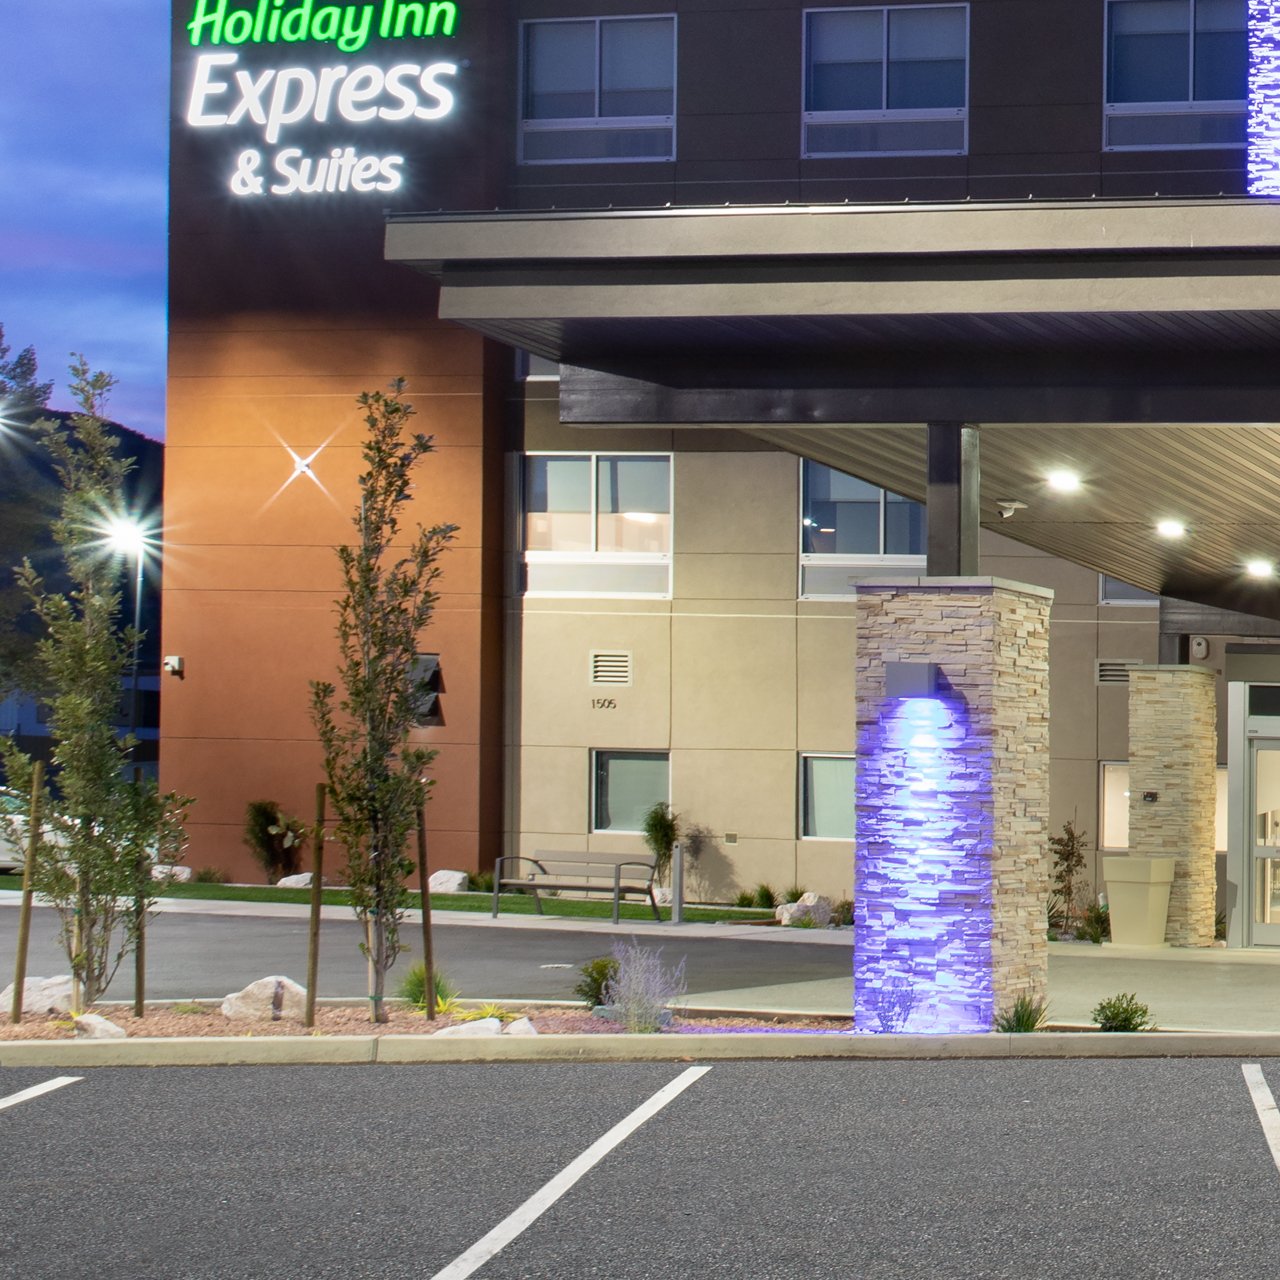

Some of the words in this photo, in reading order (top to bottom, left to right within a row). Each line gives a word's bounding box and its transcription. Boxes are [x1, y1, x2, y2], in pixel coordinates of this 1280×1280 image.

[186, 52, 457, 144] Express
[230, 149, 263, 195] &
[271, 147, 404, 195] Suites
[591, 698, 617, 709] 1505
